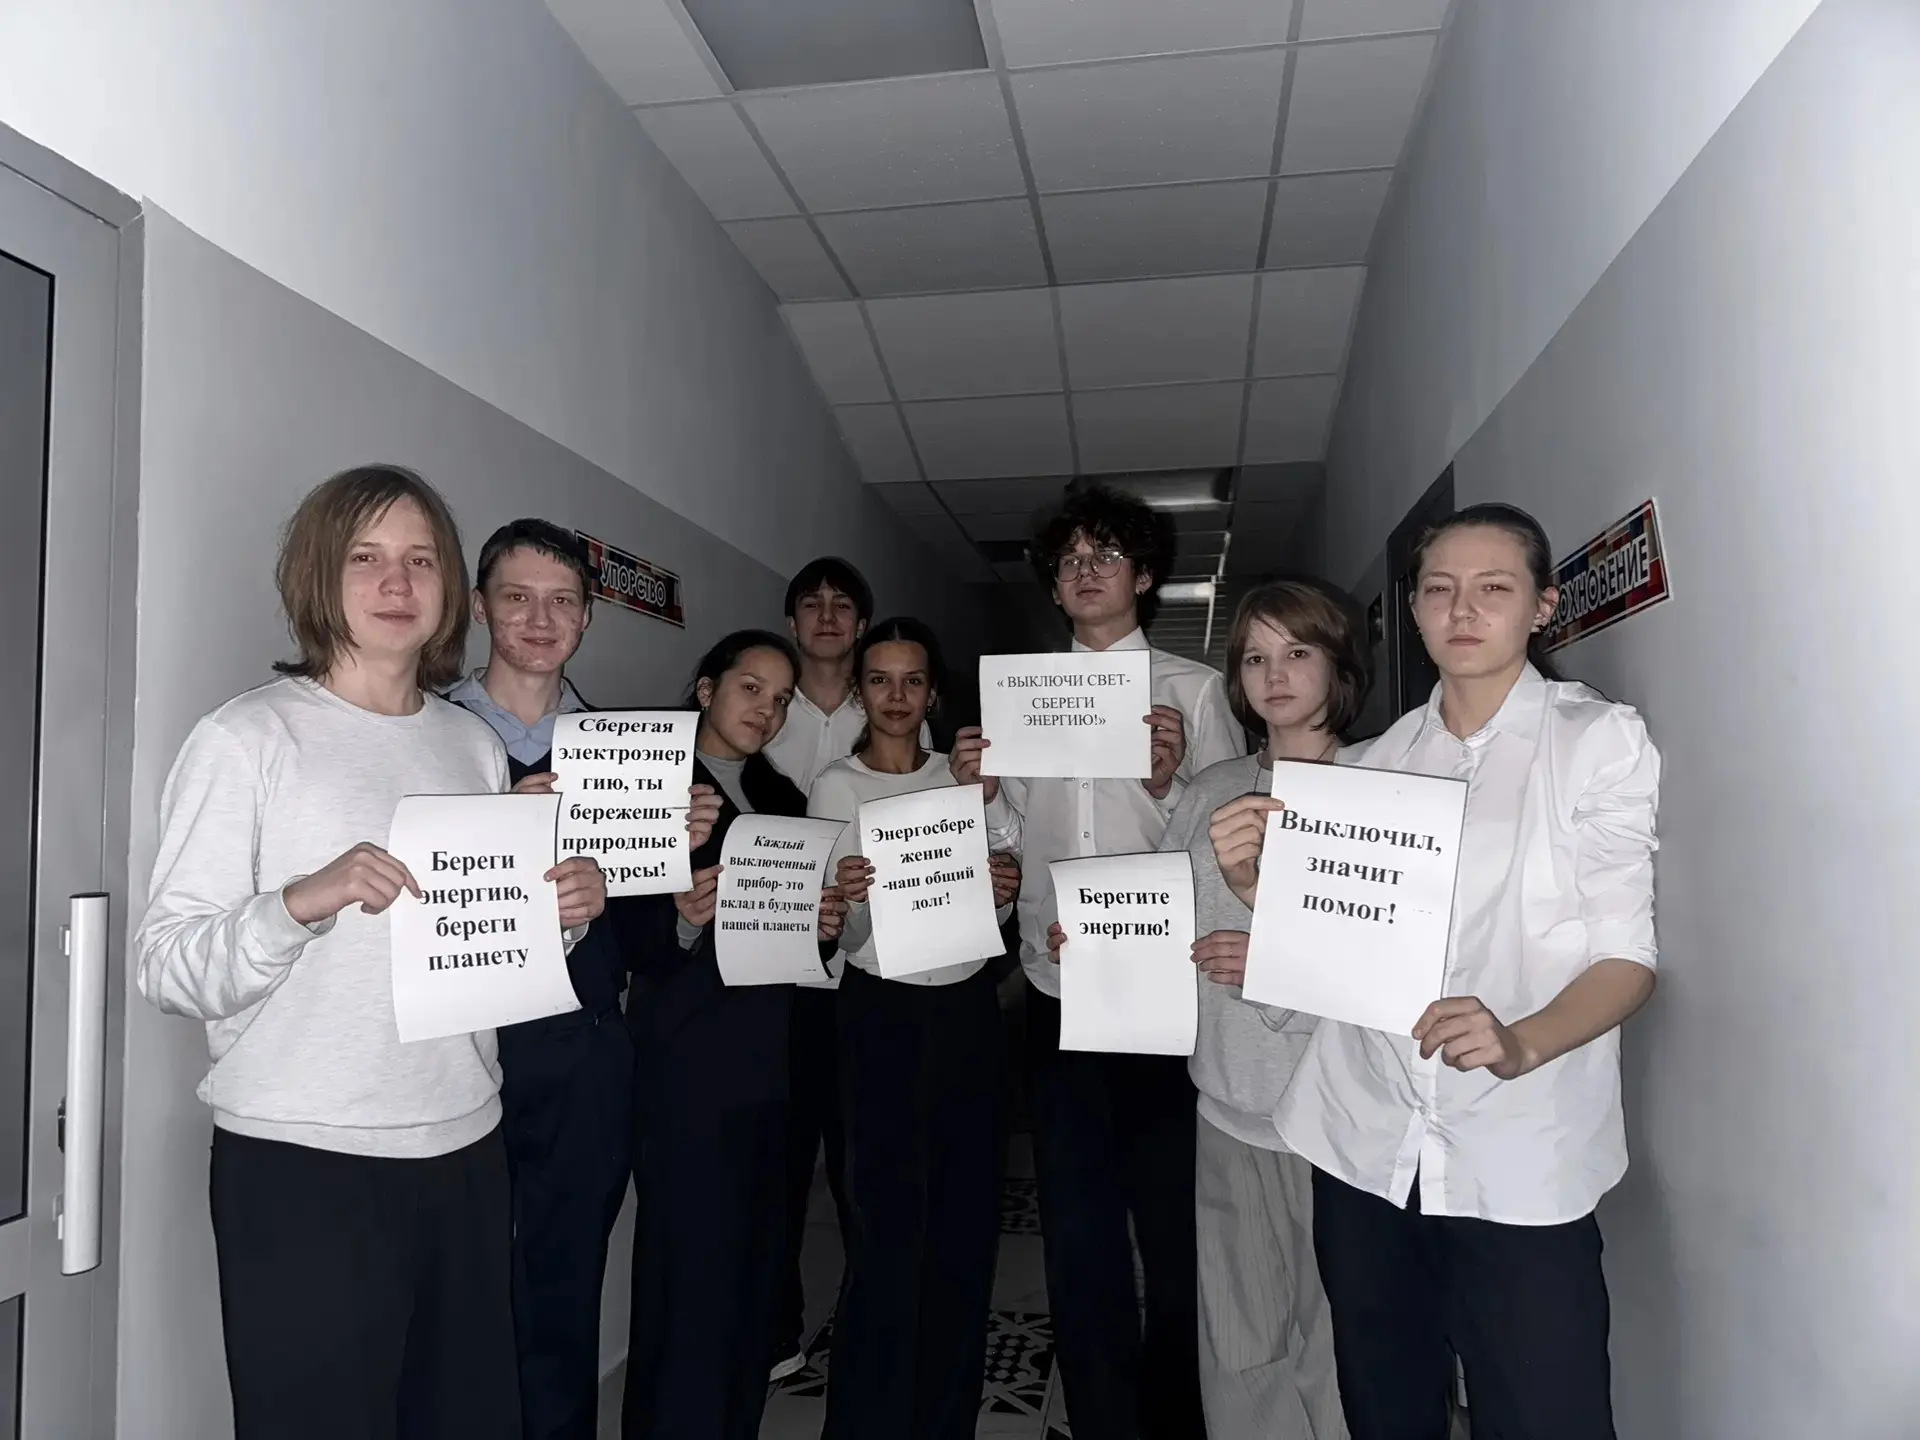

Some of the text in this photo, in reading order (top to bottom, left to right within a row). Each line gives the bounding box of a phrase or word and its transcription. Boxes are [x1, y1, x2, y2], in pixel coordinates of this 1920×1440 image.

[600, 557, 666, 607] УПОРСТВО
[1547, 532, 1650, 637] ОХНОВЕНИЕ
[1007, 675, 1083, 688] ВЫКЛЮЧИ
[1087, 674, 1131, 687] СВЕТ-
[1032, 697, 1095, 709] СБЕРЕГИ
[578, 718, 674, 735] Сберегая
[1023, 714, 1106, 726] ЭНЕРГИЮ!»
[558, 746, 687, 763] электроэнер
[582, 776, 663, 792] гию, ты
[570, 803, 672, 824] бережешь
[871, 817, 976, 843] Энергосбере
[1279, 809, 1442, 856] Выключил,
[562, 836, 678, 854] природные
[753, 835, 805, 851] Каждый
[431, 851, 515, 876] Береги
[729, 856, 817, 871] выключенный
[900, 845, 953, 864] жение
[600, 861, 667, 883] урсы!
[882, 866, 975, 892] -наш общий
[1305, 856, 1404, 885] значит
[736, 876, 804, 892] прибор- это
[420, 886, 529, 908] энергию,
[720, 898, 815, 914] вклад в будущее
[911, 892, 951, 912] долг!
[1078, 887, 1170, 907] Берегите
[1301, 893, 1397, 925] помог!
[436, 916, 516, 941] береги
[721, 919, 810, 932] нашей планеты
[1079, 918, 1170, 938] энергию!
[428, 948, 529, 971] планету
